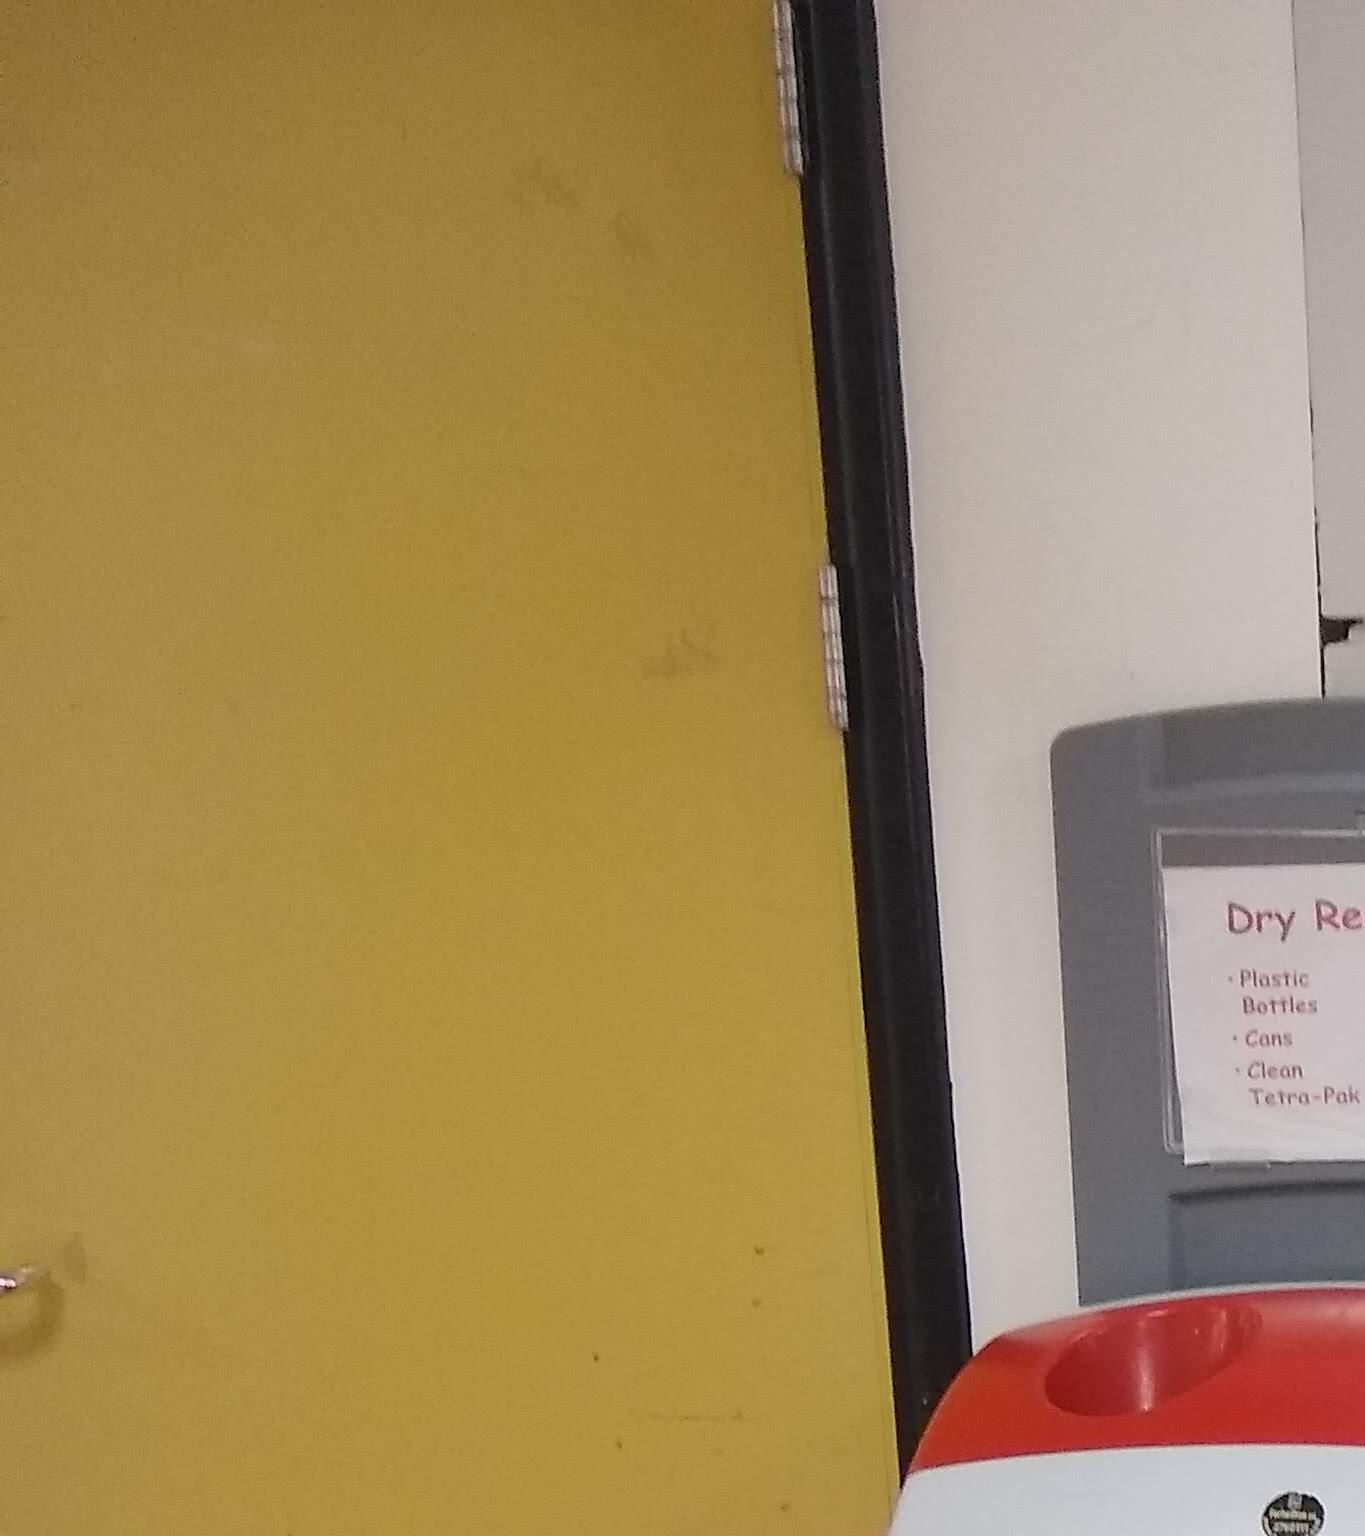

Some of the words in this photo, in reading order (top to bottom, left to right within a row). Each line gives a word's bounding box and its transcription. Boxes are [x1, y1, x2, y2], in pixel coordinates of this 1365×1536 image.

[1227, 901, 1296, 942] Dry
[1240, 968, 1309, 989] Plastic
[1242, 995, 1318, 1016] Bottles
[1245, 1029, 1293, 1049] Cans
[1247, 1061, 1303, 1081] Clean
[1249, 1086, 1361, 1107] Tetra-Pak
